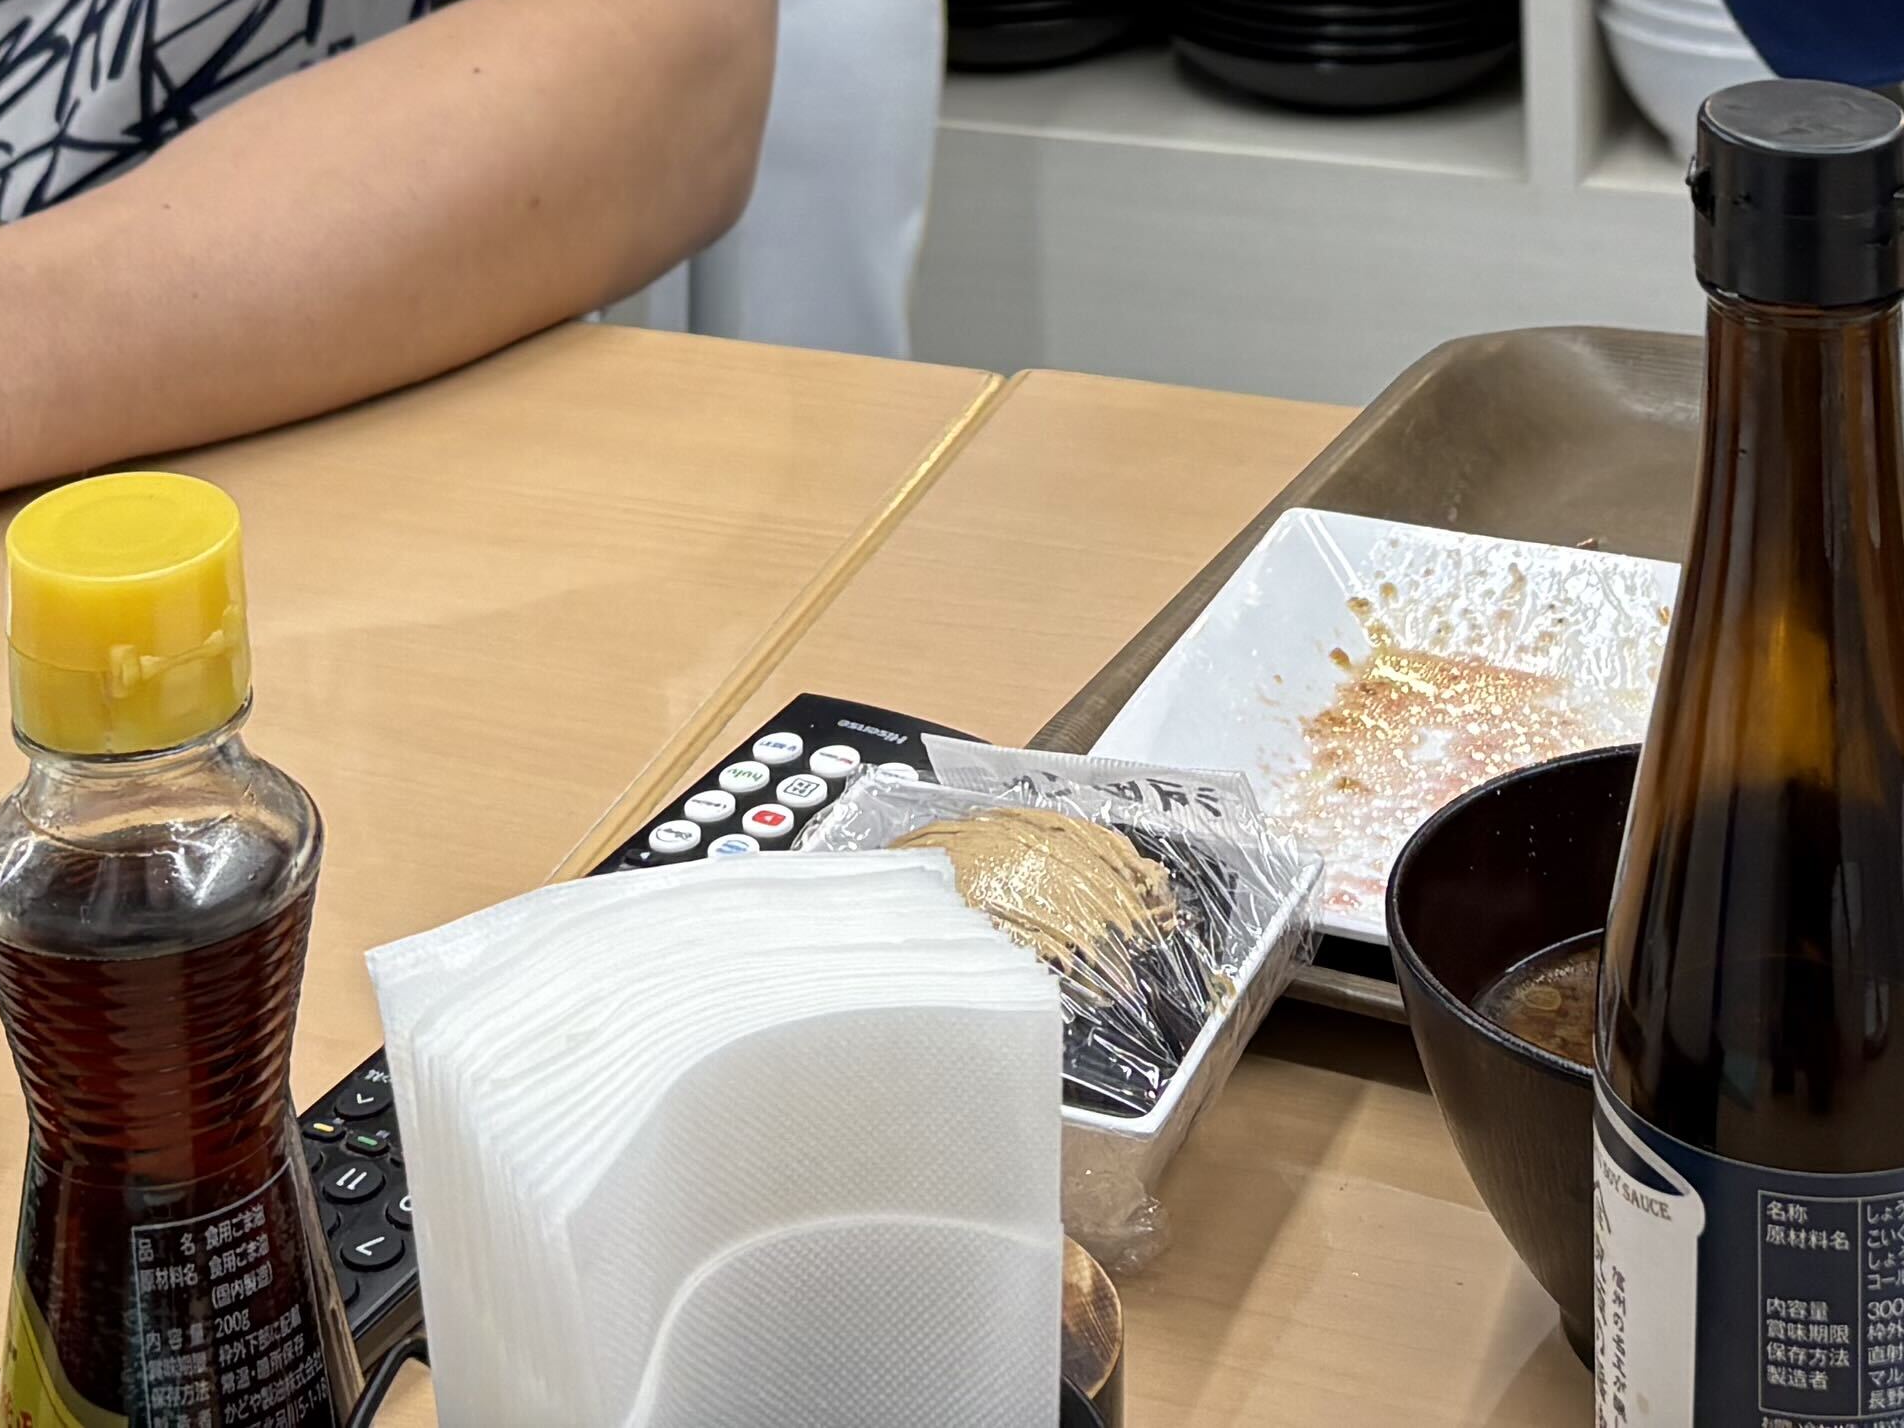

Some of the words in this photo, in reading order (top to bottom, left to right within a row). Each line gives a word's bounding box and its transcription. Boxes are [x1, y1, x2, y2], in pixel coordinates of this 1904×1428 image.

[837, 719, 908, 744] Hisense
[727, 766, 764, 782] hulu
[1622, 1183, 1673, 1222] SAUCE
[1766, 1200, 1808, 1225] 名称
[1765, 1224, 1851, 1251] 原材料名
[1765, 1296, 1830, 1322] 内容量
[214, 1308, 252, 1339] 200g
[1765, 1318, 1850, 1345] 賞味期限
[1765, 1342, 1851, 1369] 保存方法
[1765, 1364, 1830, 1391] 製造者
